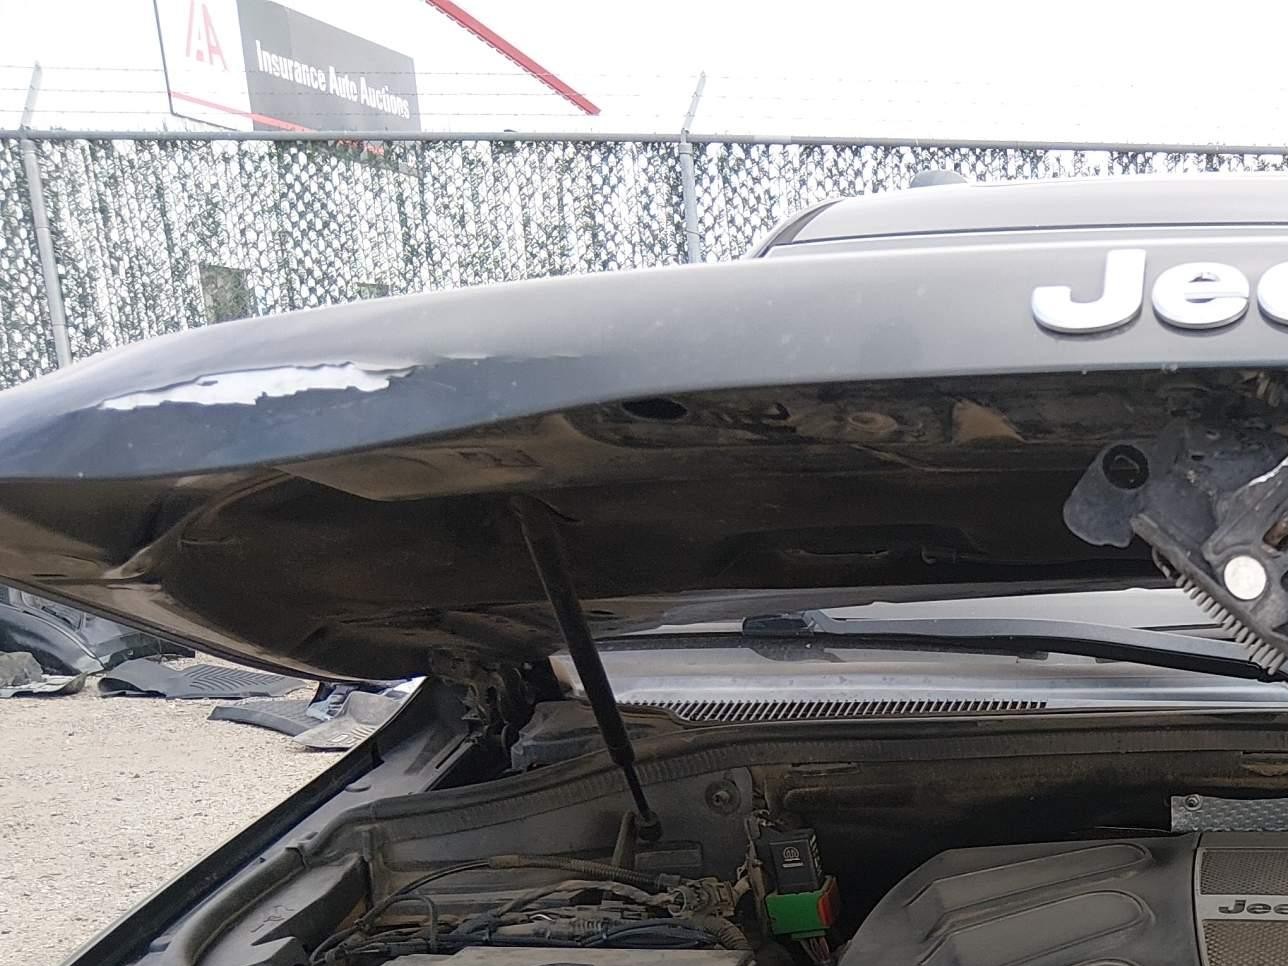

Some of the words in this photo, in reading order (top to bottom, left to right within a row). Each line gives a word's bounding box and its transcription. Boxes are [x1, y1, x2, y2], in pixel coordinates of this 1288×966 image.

[255, 39, 327, 91] Insurance
[328, 65, 358, 103] Auto
[360, 76, 410, 119] Auctions
